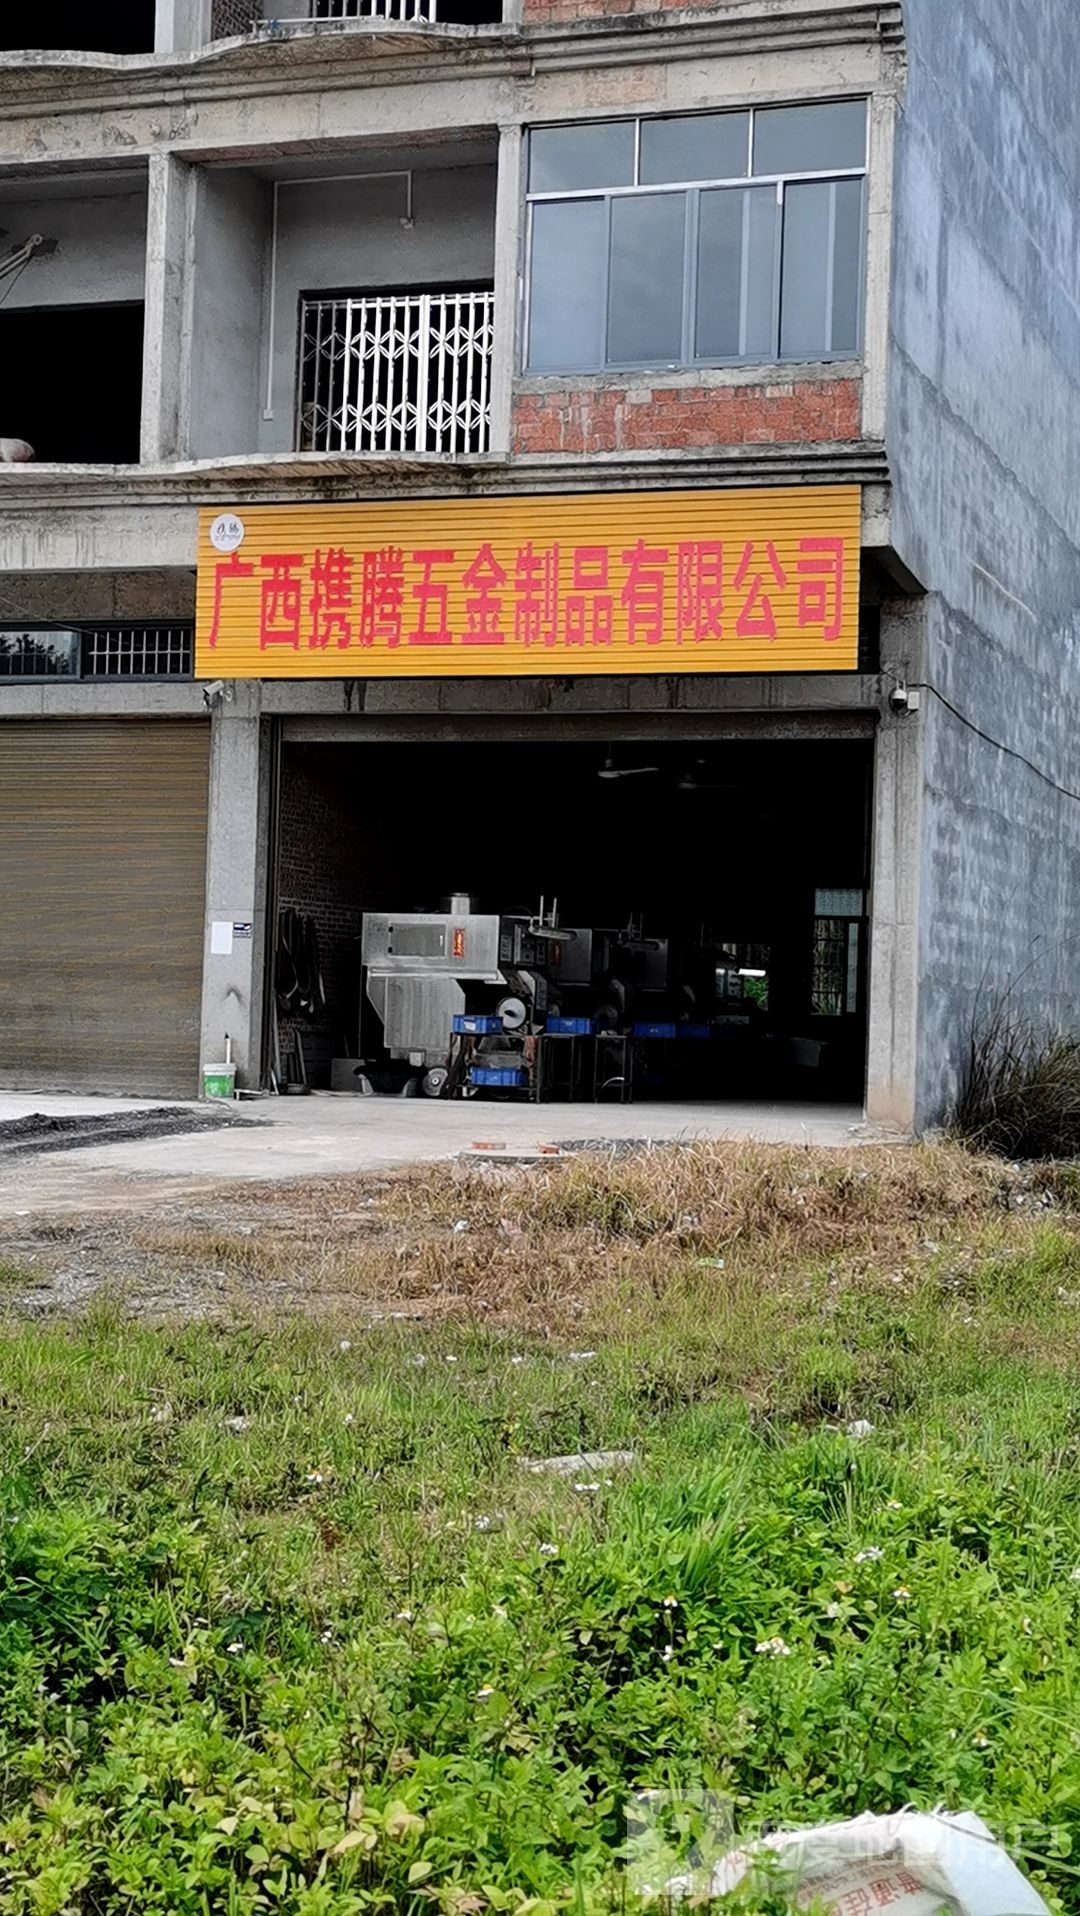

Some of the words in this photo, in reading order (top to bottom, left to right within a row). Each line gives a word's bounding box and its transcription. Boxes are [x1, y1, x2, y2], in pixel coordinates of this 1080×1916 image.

[208, 537, 845, 649] 广西携腾五金制品有限公司
